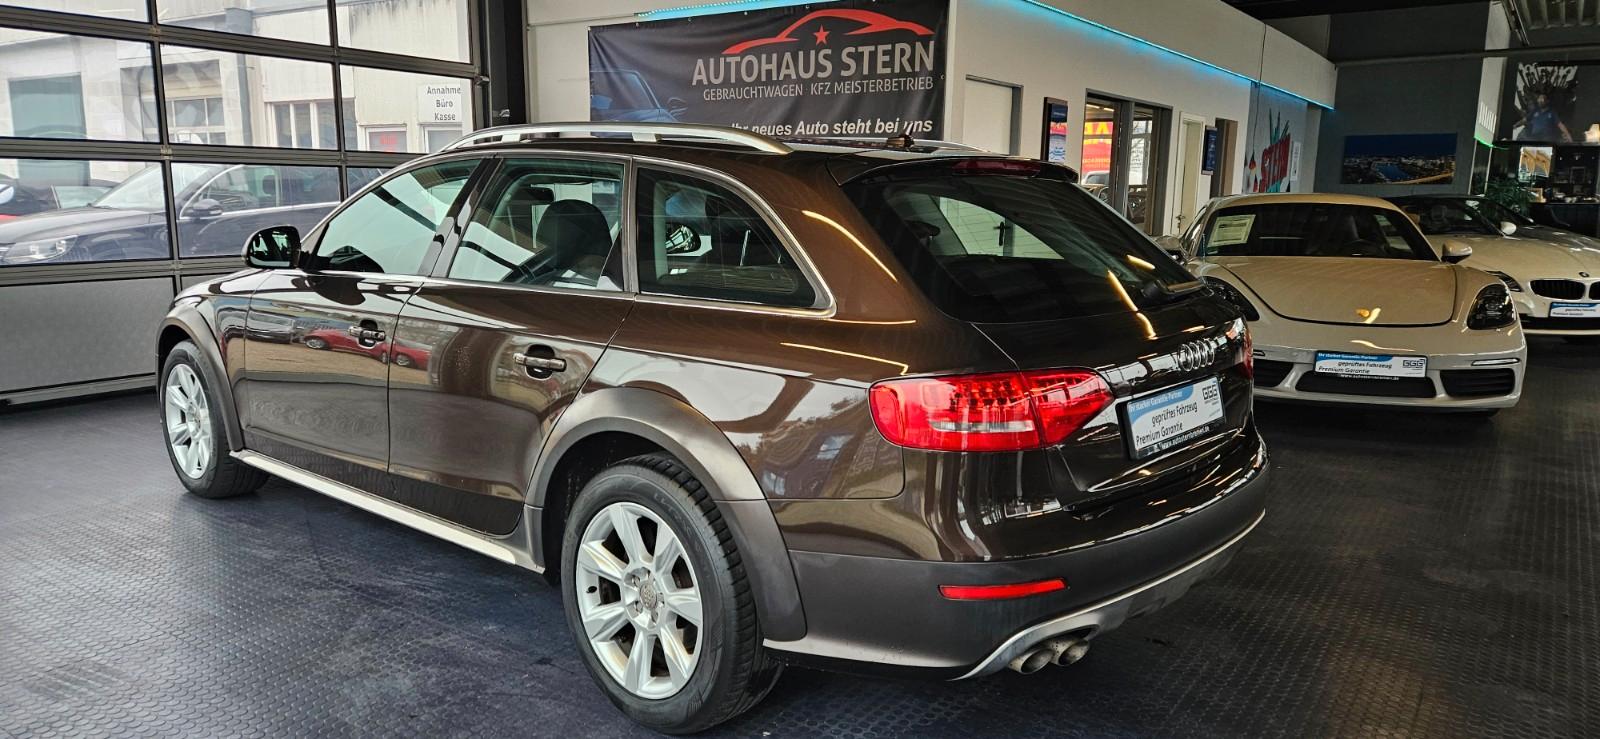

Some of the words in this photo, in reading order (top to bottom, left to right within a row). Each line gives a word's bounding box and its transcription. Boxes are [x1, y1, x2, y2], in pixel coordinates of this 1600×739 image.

[692, 49, 833, 86] AUTOHAUS
[840, 41, 935, 77] STERN
[427, 86, 462, 95] Annahme
[703, 83, 803, 101] GEBRAUCHTWAGEN
[810, 81, 831, 96] KFZ
[834, 76, 934, 94] MEISTERBETRIEB
[436, 99, 454, 108] Büro
[434, 113, 456, 121] Kasse
[752, 124, 792, 136] neues
[795, 120, 829, 135] Auto
[833, 119, 872, 134] steht
[874, 117, 900, 133] bei
[1151, 408, 1176, 427] geprüftes
[1176, 402, 1198, 416] Fahrzeug
[1135, 430, 1161, 446] Premium
[1161, 422, 1183, 436] Garantie
